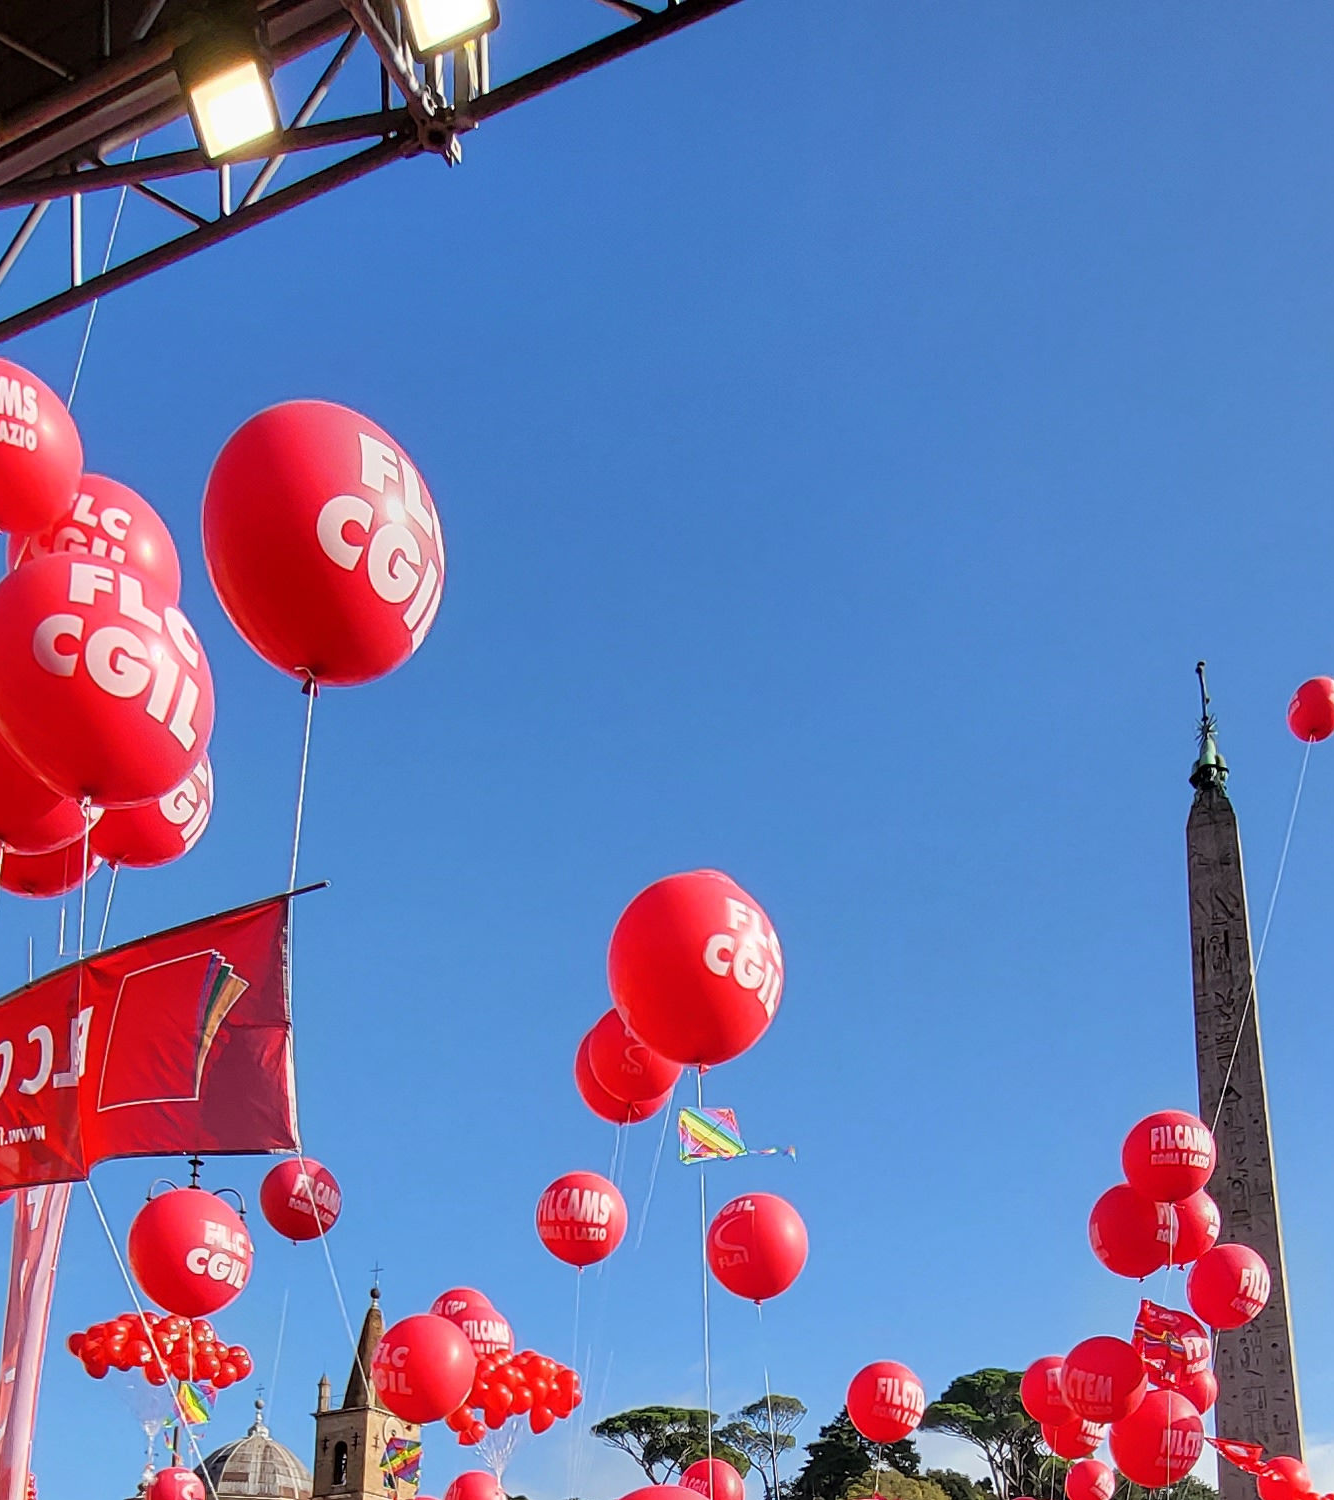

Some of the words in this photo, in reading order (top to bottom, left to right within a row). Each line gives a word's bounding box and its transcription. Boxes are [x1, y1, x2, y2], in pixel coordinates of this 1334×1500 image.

[68, 562, 199, 668] FLC
[32, 613, 200, 751] CGIL
[186, 1248, 247, 1292] CGIL
